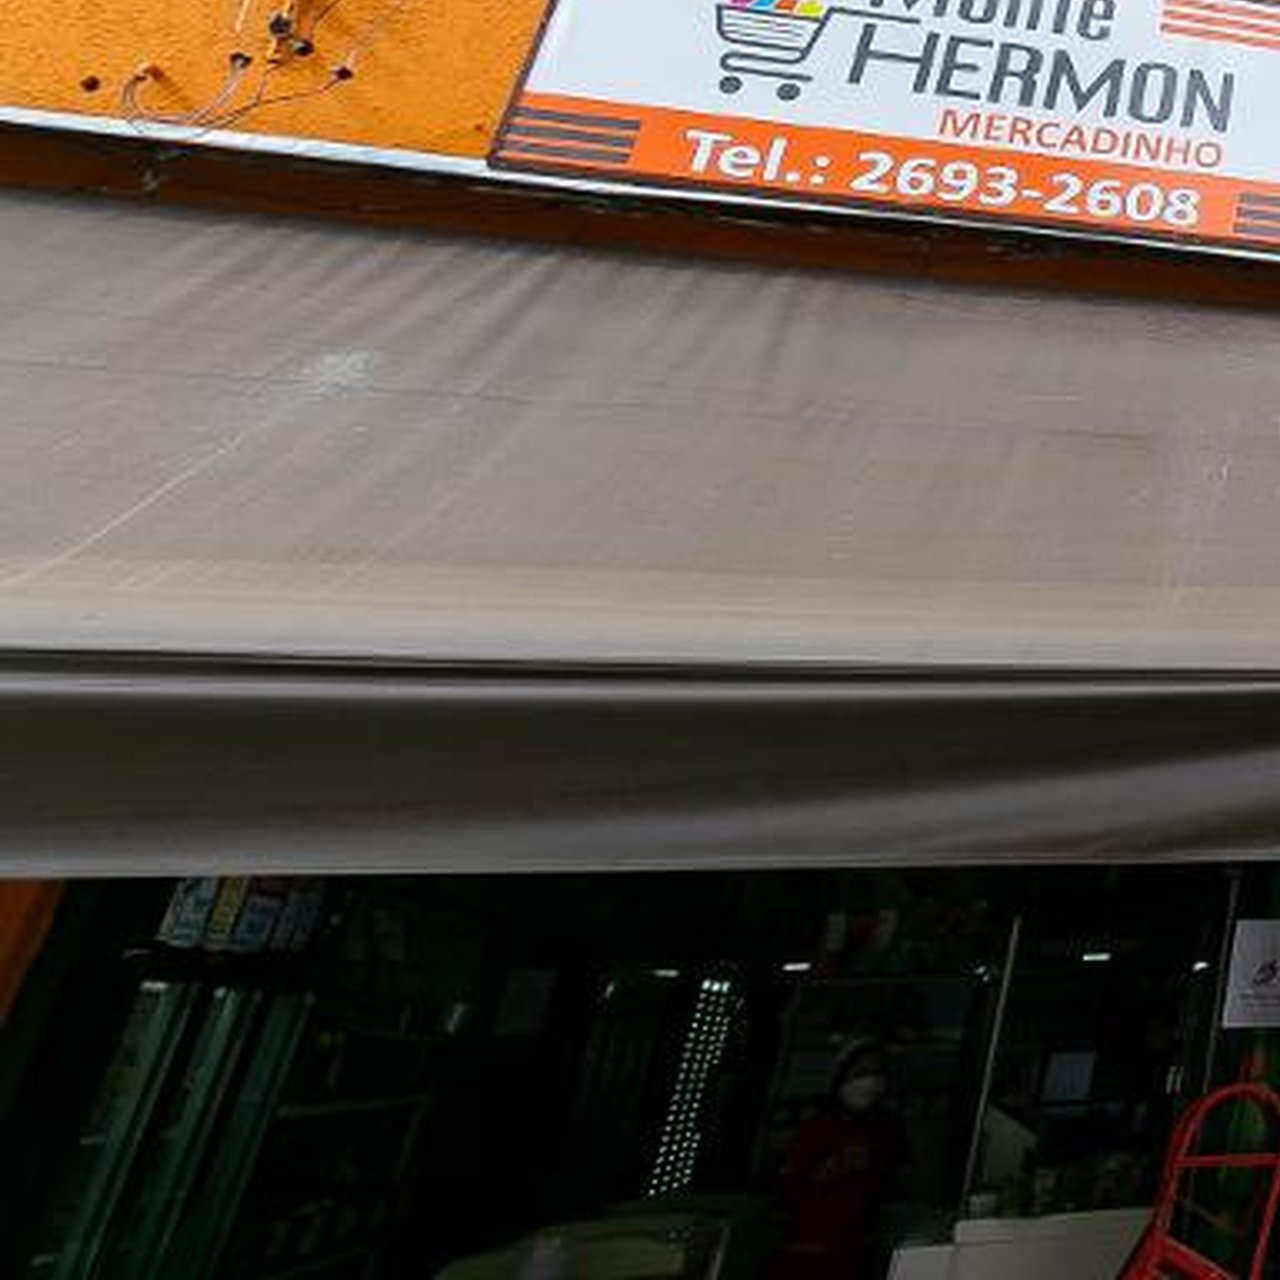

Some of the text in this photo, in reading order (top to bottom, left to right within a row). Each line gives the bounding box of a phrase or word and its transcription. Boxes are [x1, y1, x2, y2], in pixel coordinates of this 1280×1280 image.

[847, 23, 1236, 133] HERMON
[684, 128, 1201, 227] Tel.: 2693-2608
[938, 109, 1223, 170] MERCADINHO
